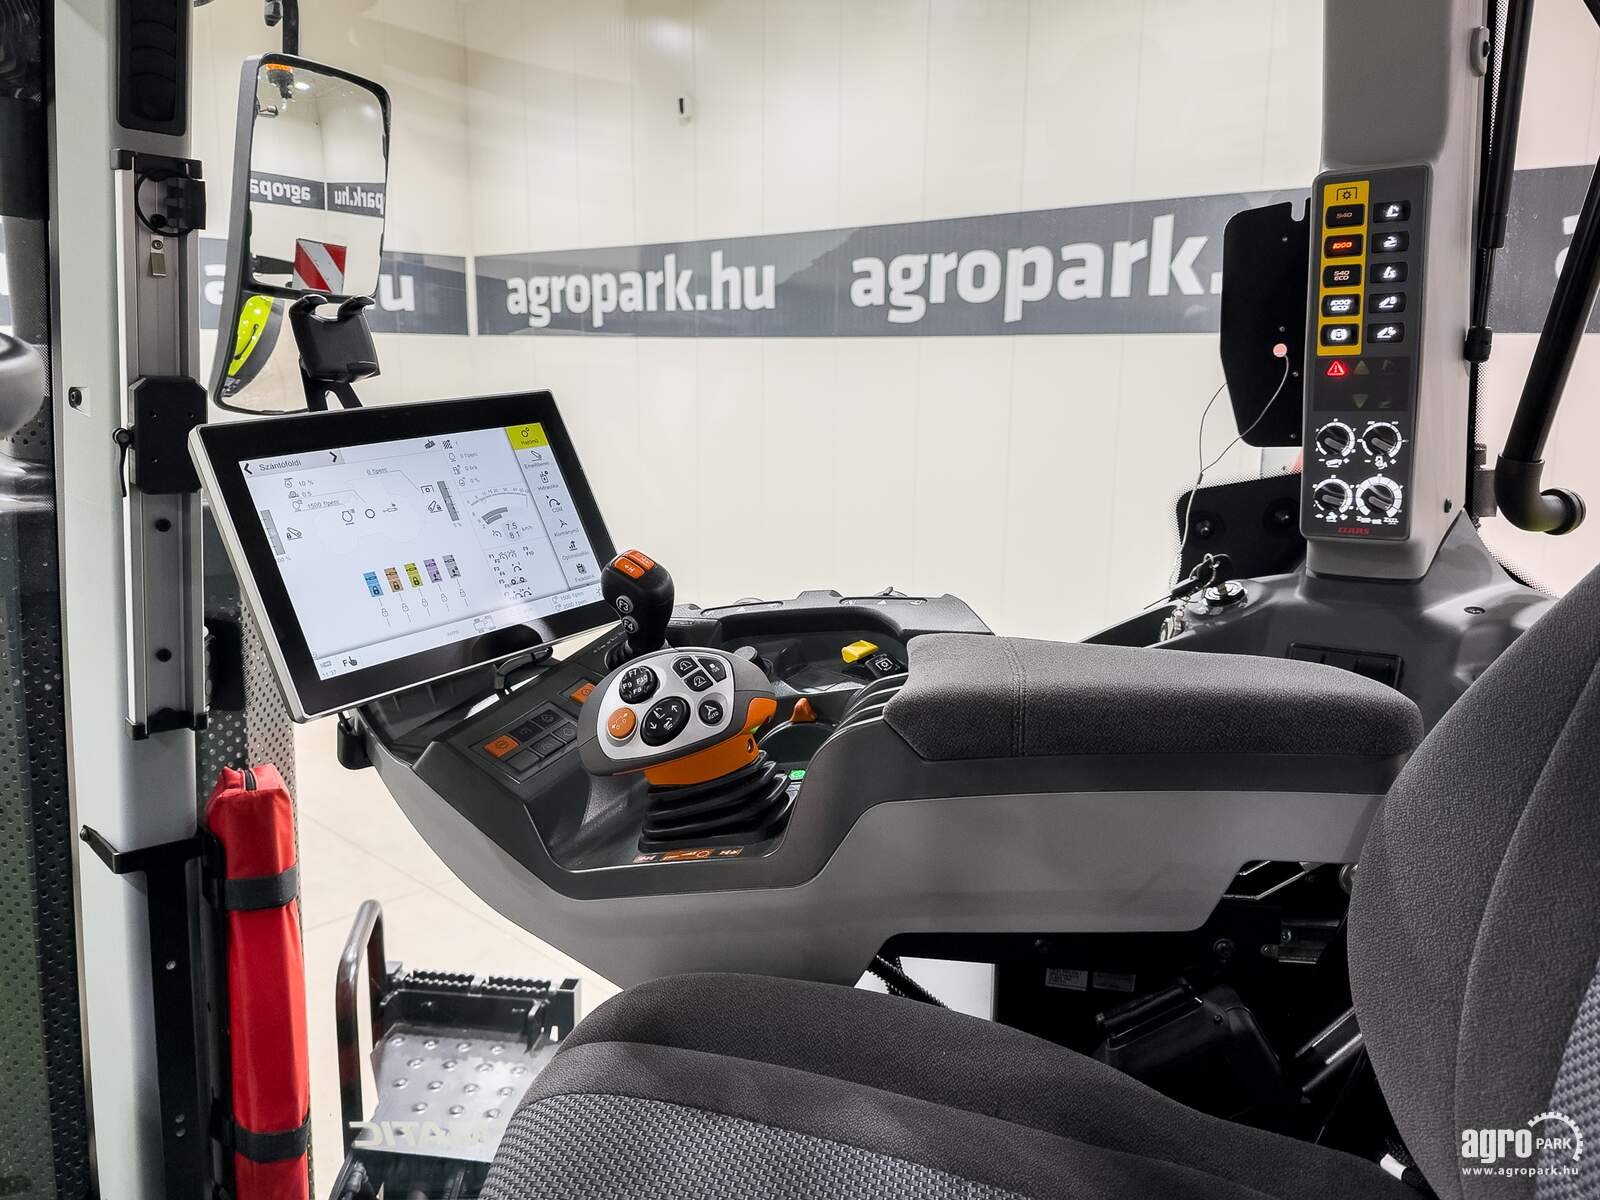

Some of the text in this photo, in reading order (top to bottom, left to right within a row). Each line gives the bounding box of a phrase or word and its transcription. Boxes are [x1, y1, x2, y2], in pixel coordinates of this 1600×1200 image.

[1332, 241, 1353, 249] 1000
[506, 251, 776, 328] agropark.hu
[620, 600, 629, 611] F3
[624, 620, 634, 631] F4
[628, 669, 637, 677] F7
[636, 674, 648, 684] F10
[622, 682, 632, 690] F9
